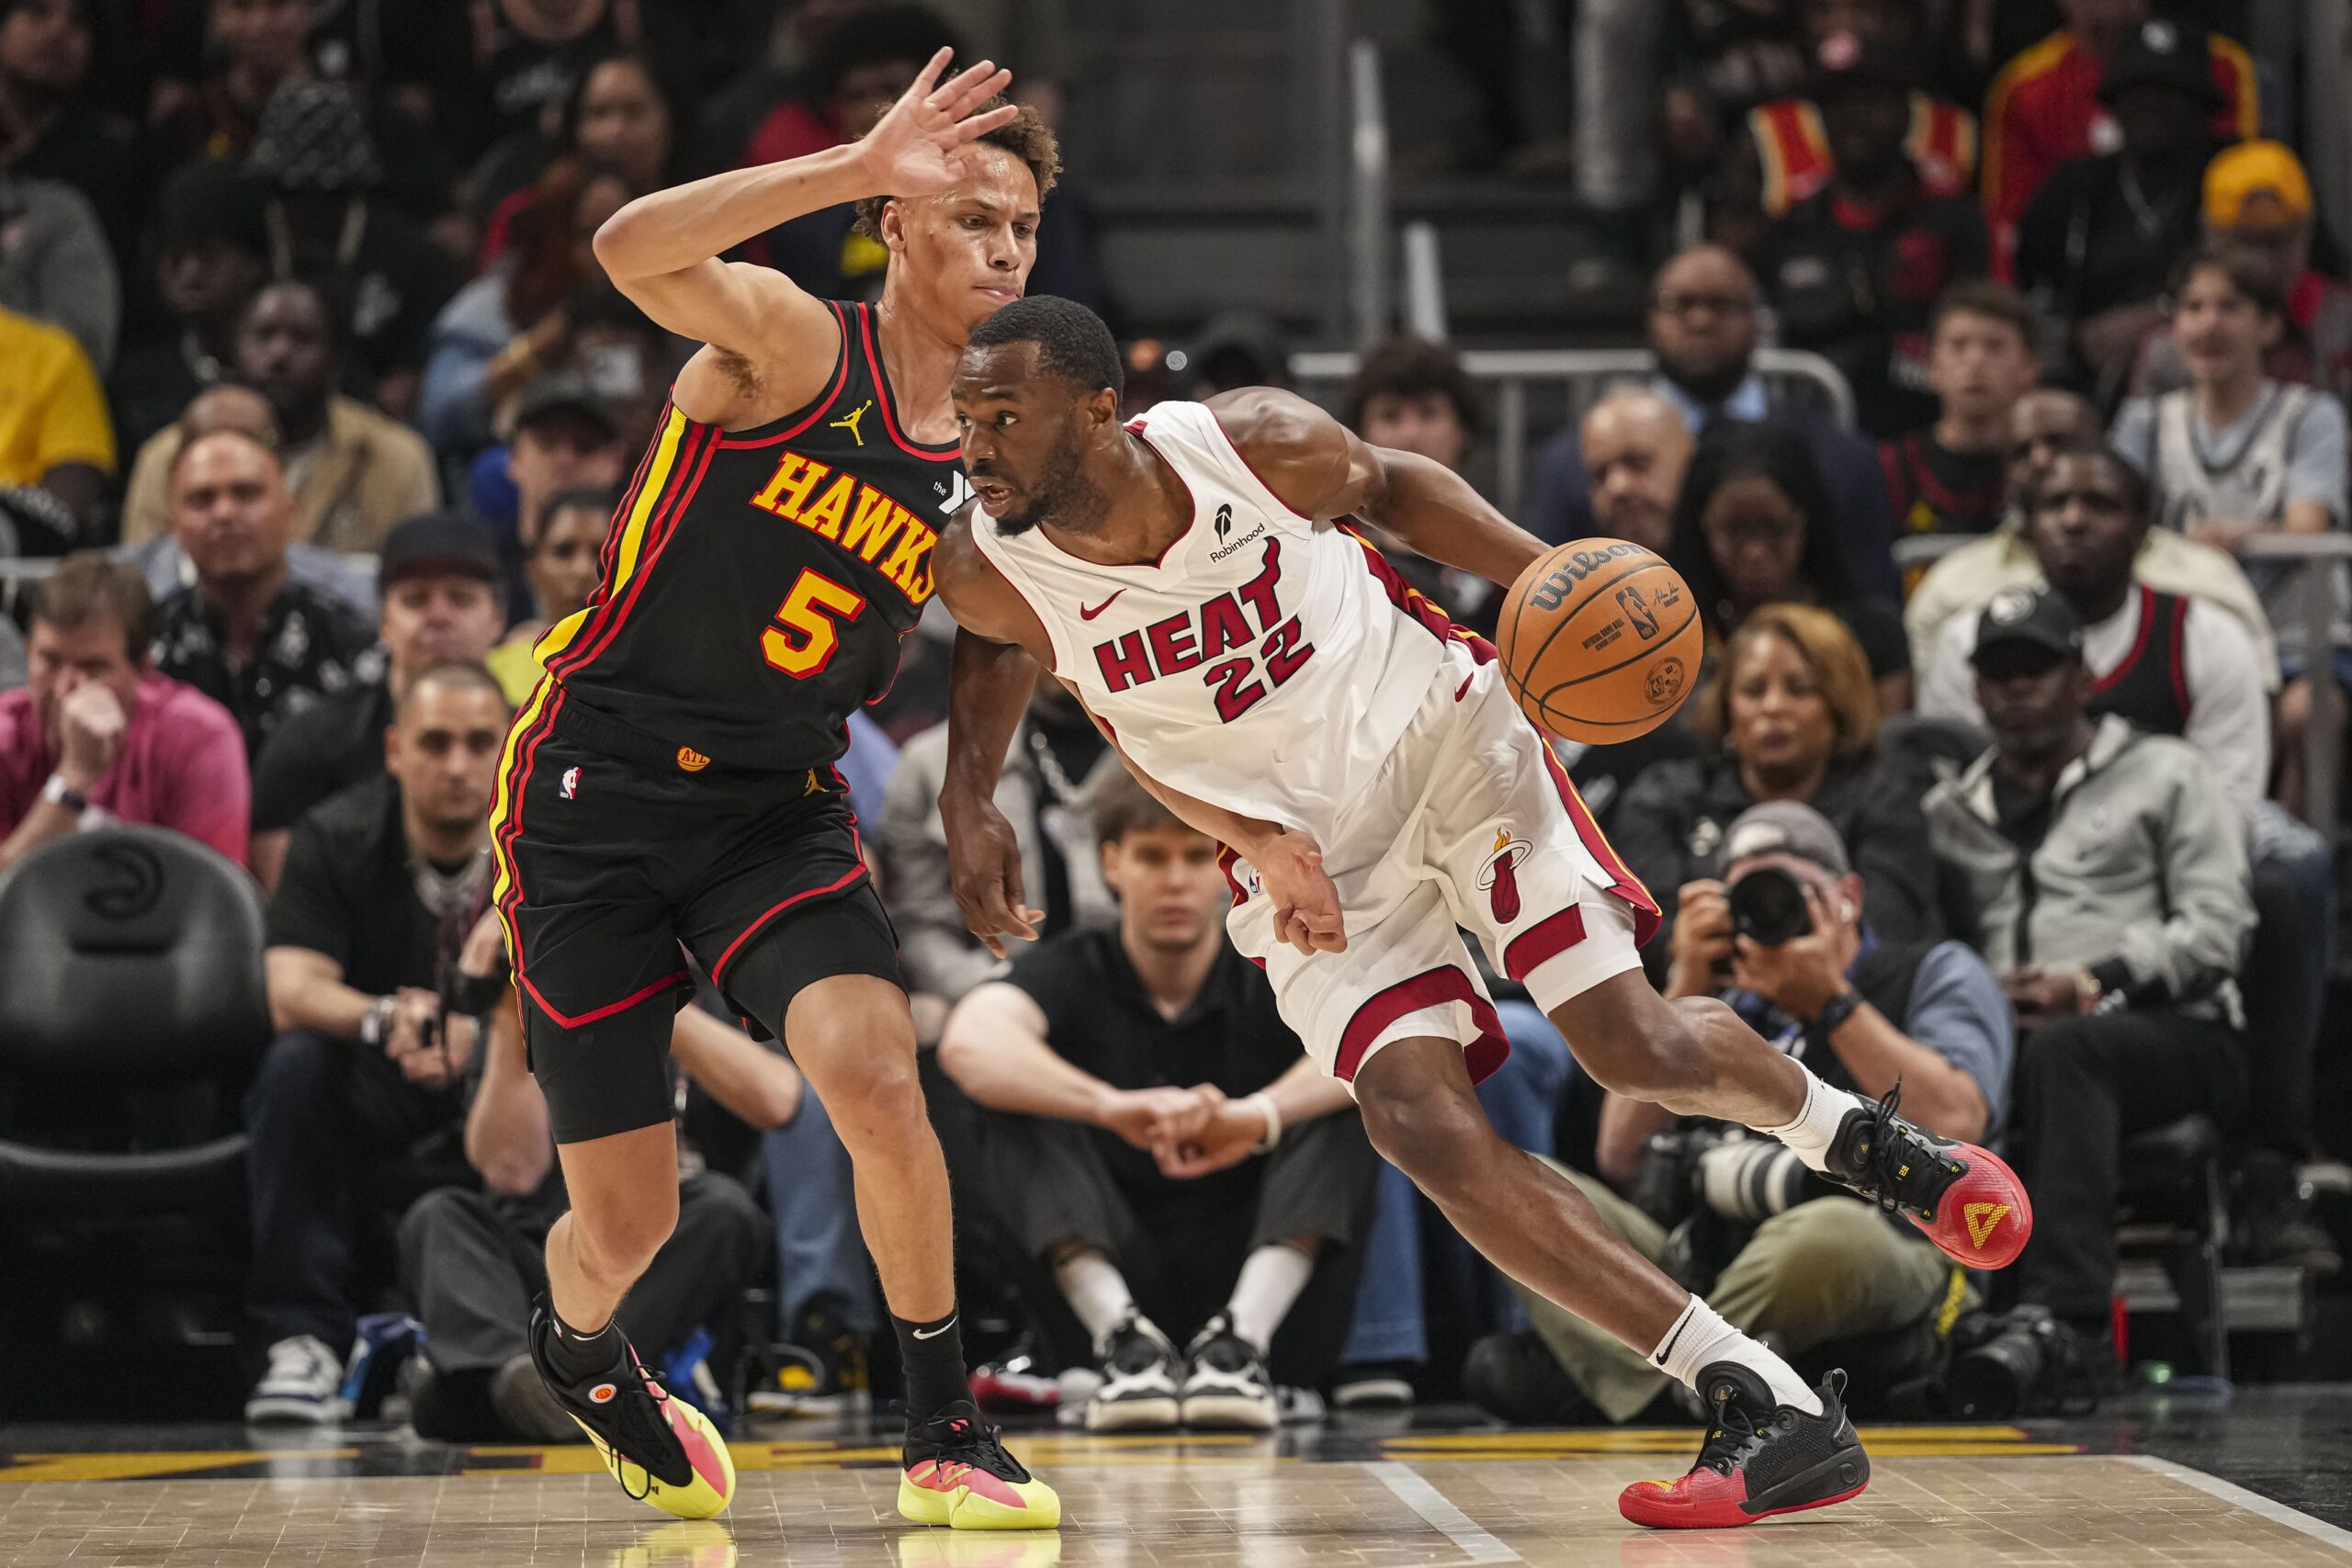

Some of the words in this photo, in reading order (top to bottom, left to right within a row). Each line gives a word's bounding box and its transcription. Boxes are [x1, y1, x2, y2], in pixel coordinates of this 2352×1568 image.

[933, 481, 947, 496] the
[1210, 523, 1265, 562] Robinhood
[1529, 544, 1652, 612] Wilson
[759, 566, 866, 680] 5
[1093, 536, 1282, 693] HEAT
[1203, 614, 1316, 724] 22
[681, 749, 707, 763] ATL
